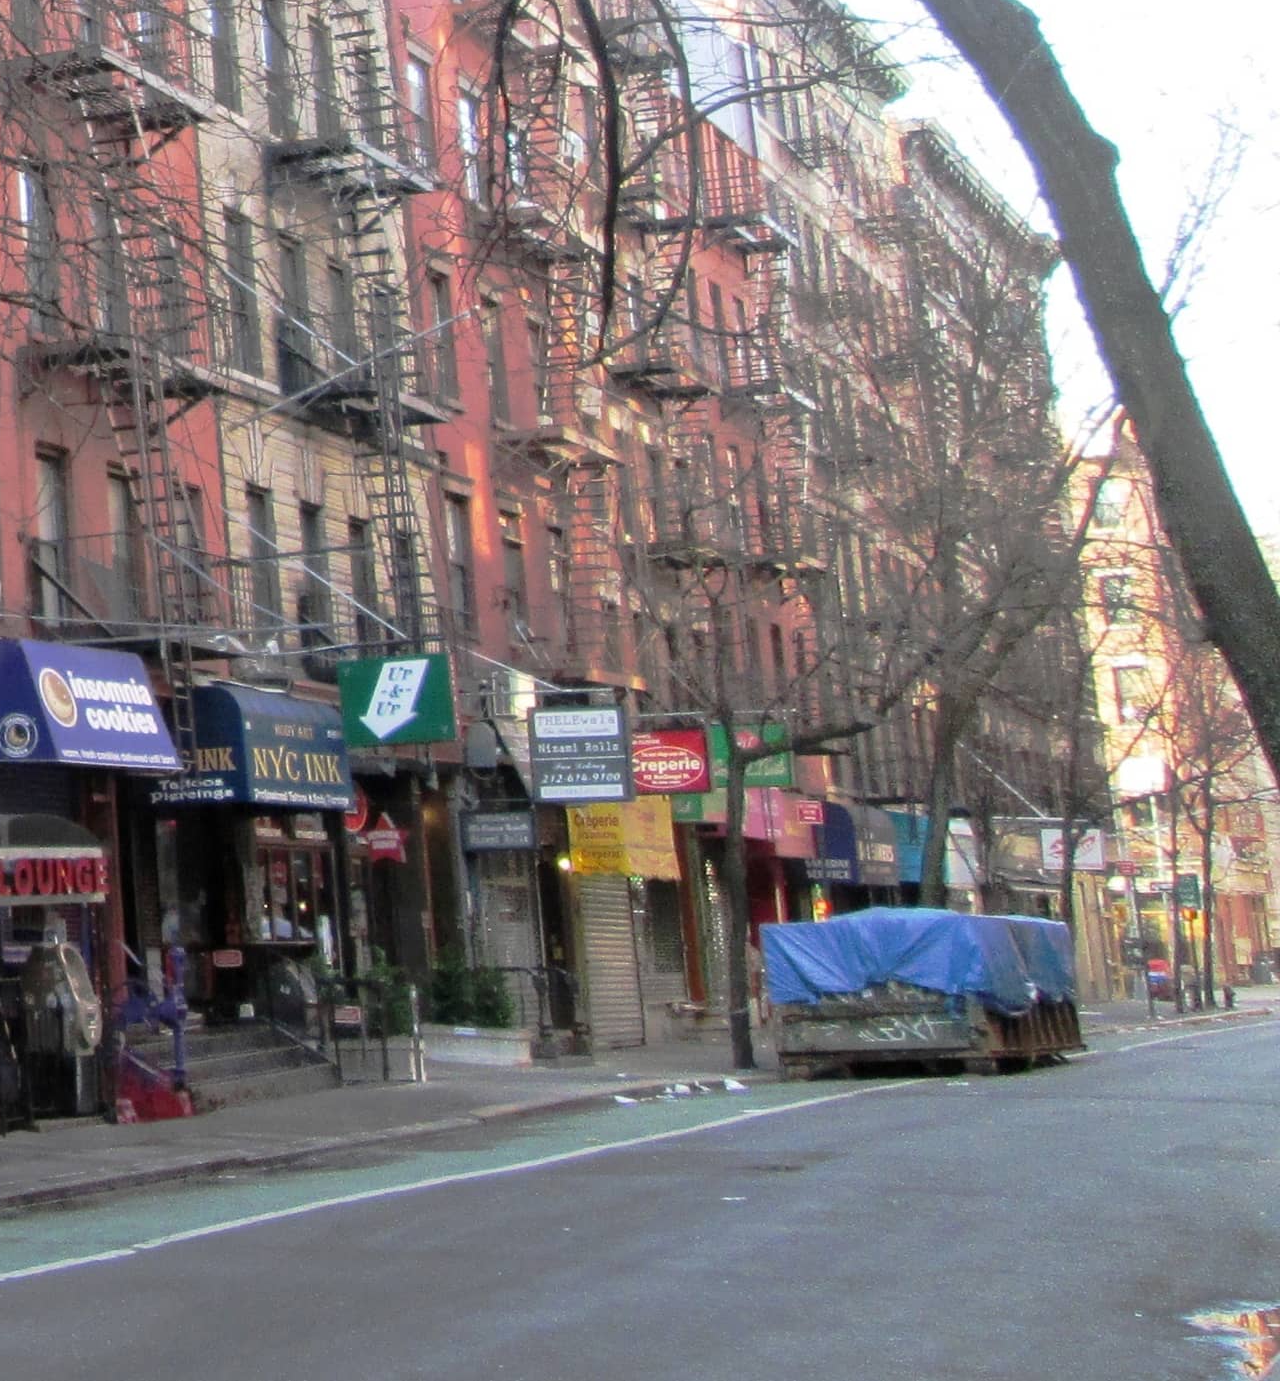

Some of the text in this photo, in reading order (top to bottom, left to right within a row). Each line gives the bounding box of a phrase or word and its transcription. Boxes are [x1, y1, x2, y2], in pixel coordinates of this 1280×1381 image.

[66, 670, 153, 707] insomnia
[85, 703, 159, 735] cookies
[196, 747, 237, 773] INK
[537, 740, 620, 754] Nizami Rolls
[252, 745, 343, 783] NYC INK
